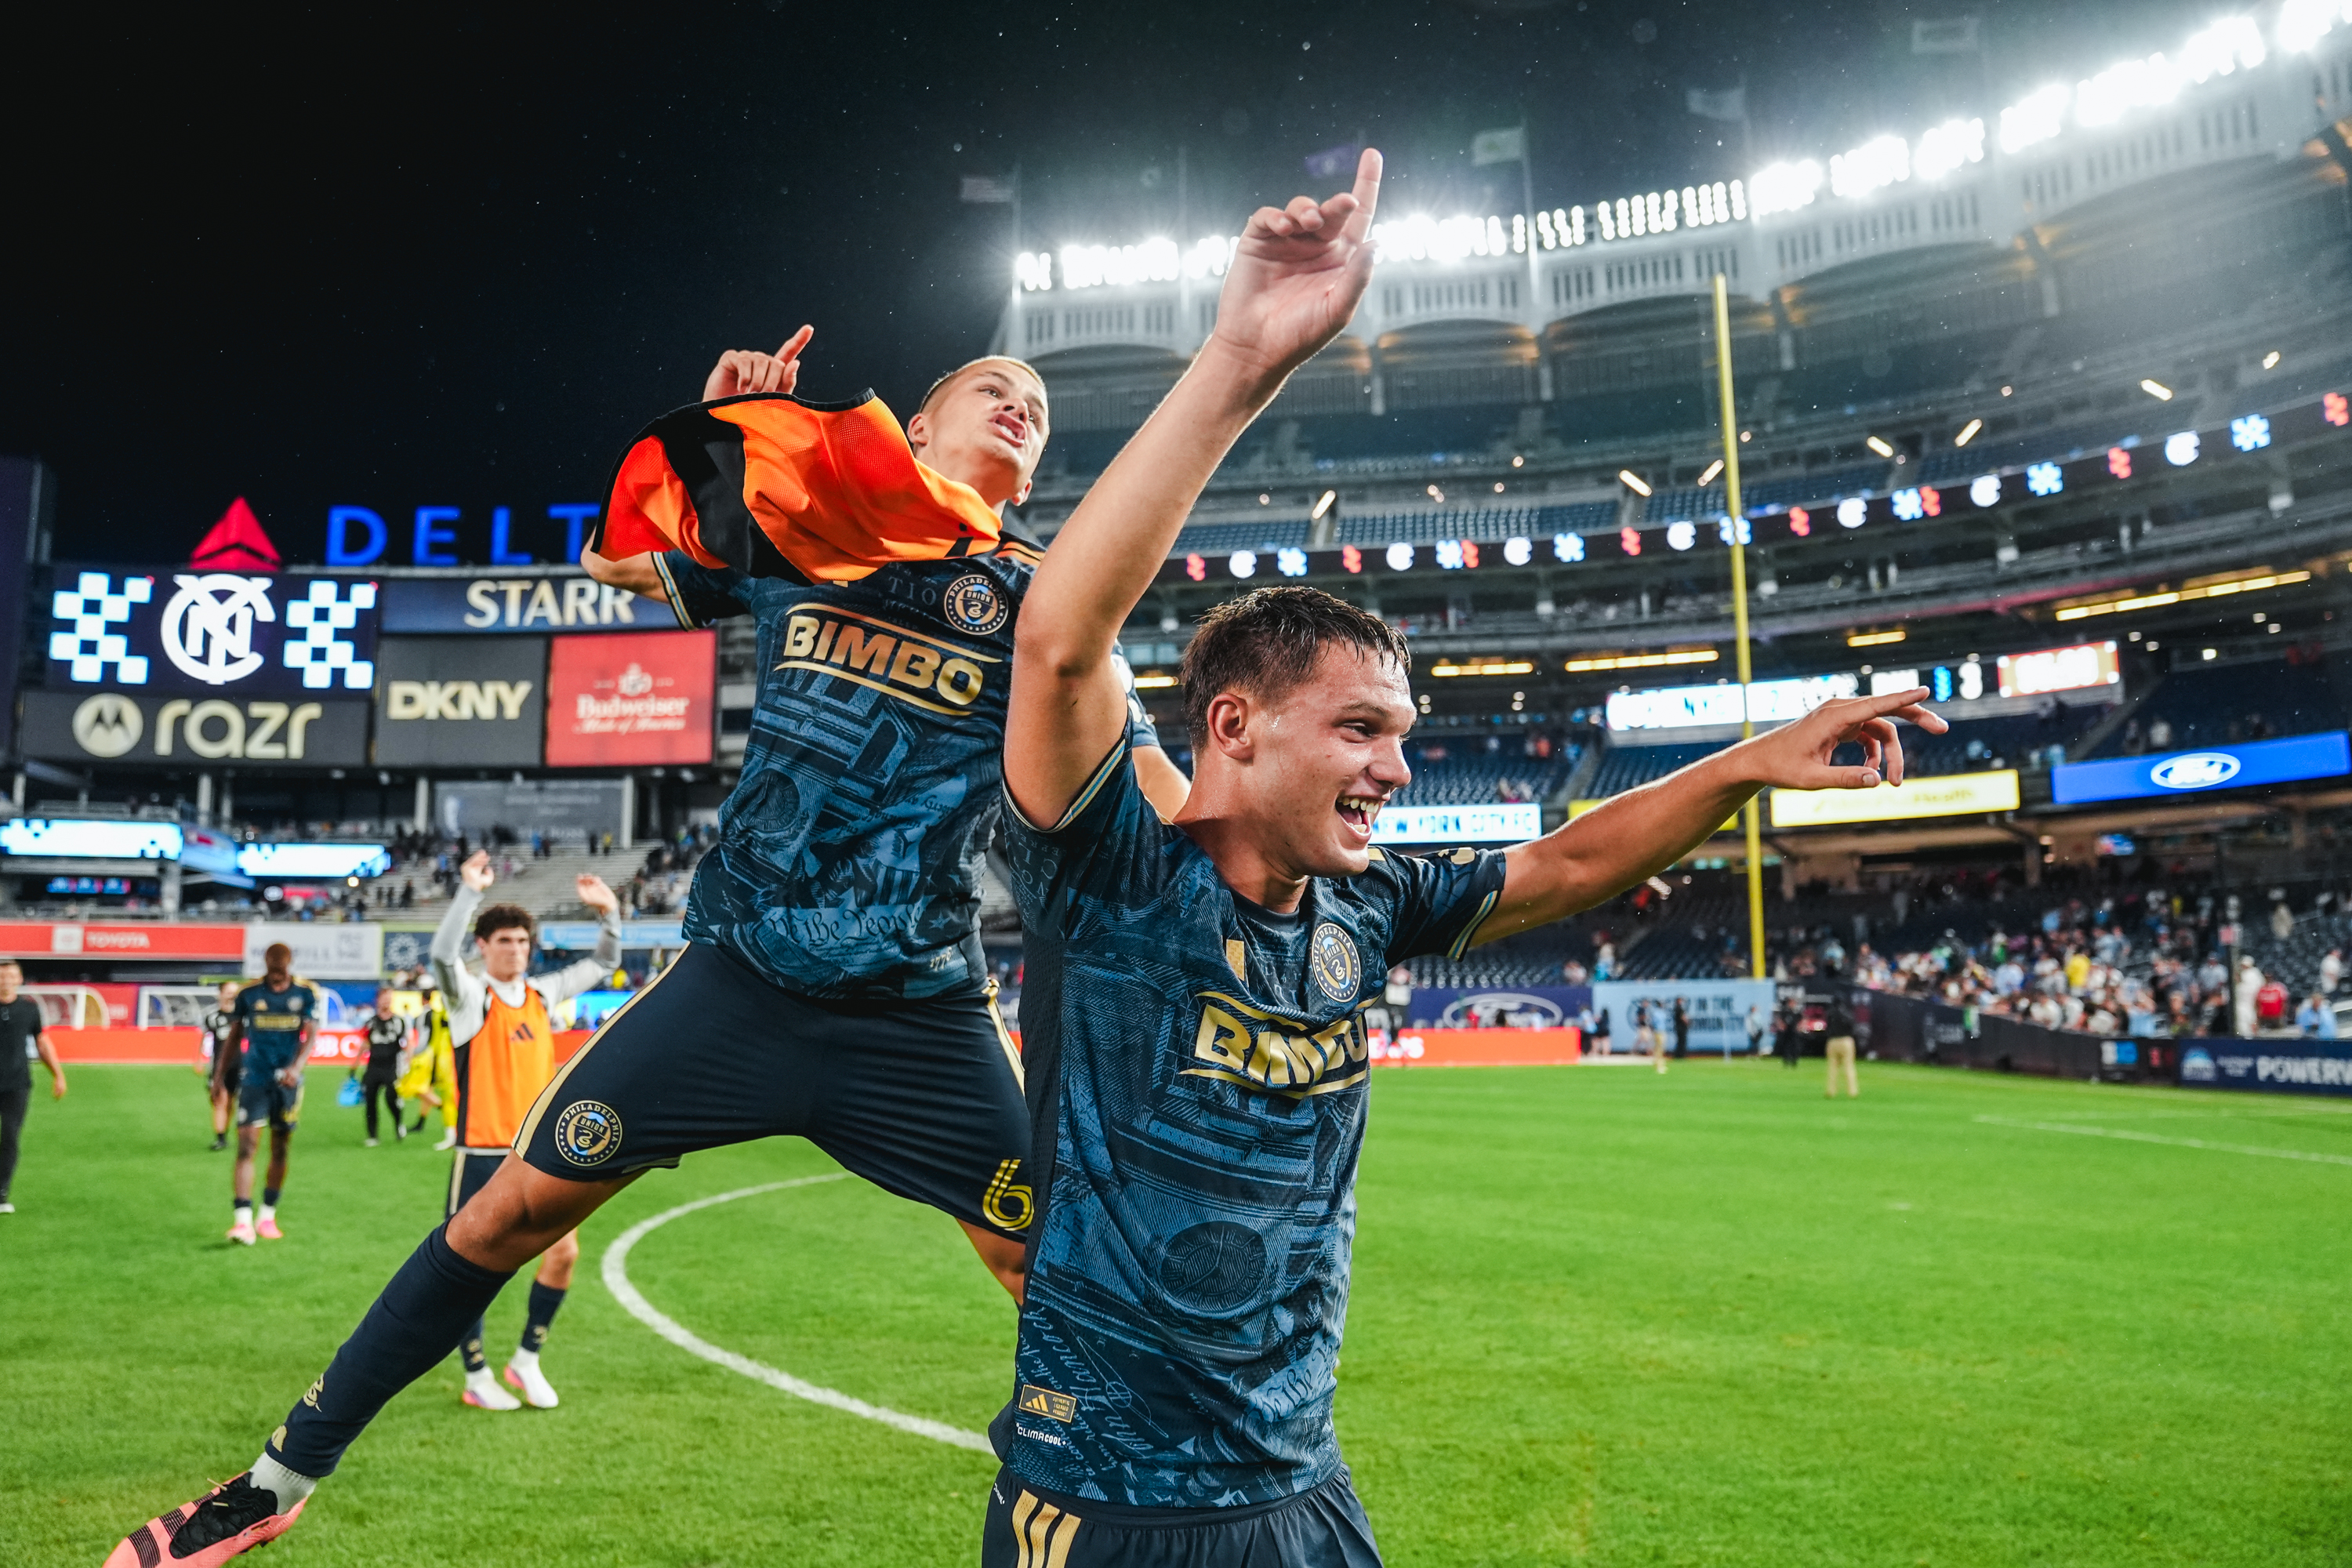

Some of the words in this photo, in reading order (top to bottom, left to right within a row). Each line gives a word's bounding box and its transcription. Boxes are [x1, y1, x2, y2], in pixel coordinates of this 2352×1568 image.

[325, 506, 600, 566] DELT
[464, 579, 636, 628] STARR
[967, 591, 991, 602] UNION
[784, 616, 983, 706] BIMBO
[387, 681, 532, 720] DKNY
[577, 694, 690, 718] Budweiser
[155, 699, 321, 759] razr
[1372, 816, 1408, 834] NEW
[1418, 815, 1461, 833] YORK
[1471, 813, 1505, 833] CITY
[1514, 812, 1533, 831] FC
[86, 931, 150, 948] TOYOTA
[1315, 927, 1351, 972] PHILADELPHIA
[1324, 944, 1340, 961] UNION
[564, 1104, 619, 1142] PHILADELPHIA
[580, 1117, 604, 1134] UNION
[983, 1159, 1034, 1232] 6
[1052, 1397, 1070, 1406] AUTHENTIC
